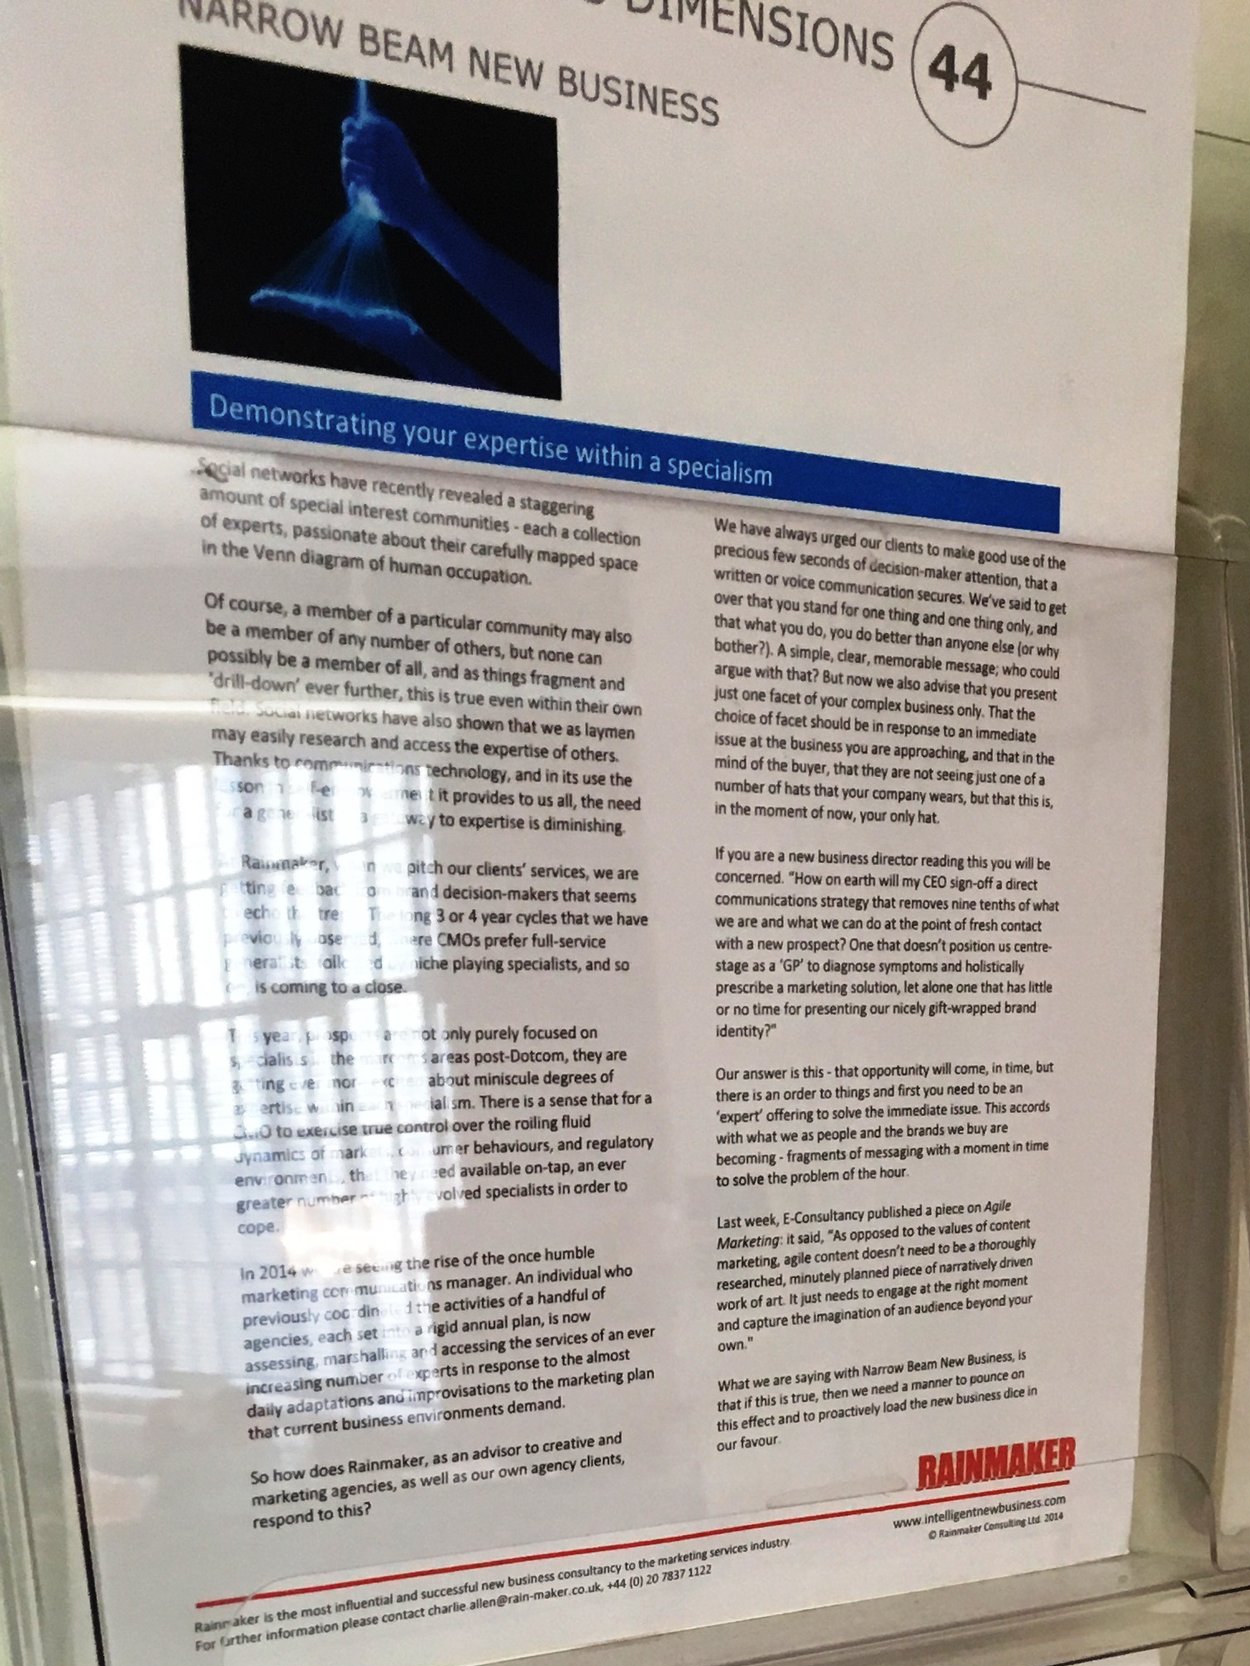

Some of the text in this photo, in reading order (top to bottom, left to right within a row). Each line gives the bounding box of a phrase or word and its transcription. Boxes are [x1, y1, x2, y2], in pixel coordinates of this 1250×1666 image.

[178, 0, 721, 127] NARROW BEAM NEW BUSINESS
[928, 43, 993, 101] 44
[210, 394, 771, 486] Demonstrating your expertise within a specialism
[714, 637, 1059, 679] bother?). A simple, clear, memorable message; who could
[250, 1431, 621, 1484] So how does Rainmaker, as an advisor to creative and
[916, 1437, 1076, 1491] RAINMAKER
[893, 1496, 1066, 1528] www.intelligentnewbusiness.com
[342, 1615, 378, 1632] please
[381, 1607, 425, 1623] contact
[607, 1578, 626, 1589] +44
[629, 1575, 643, 1589] (0)
[646, 1573, 658, 1584] 20
[661, 1568, 685, 1581] 7837
[688, 1564, 711, 1577] 1122
